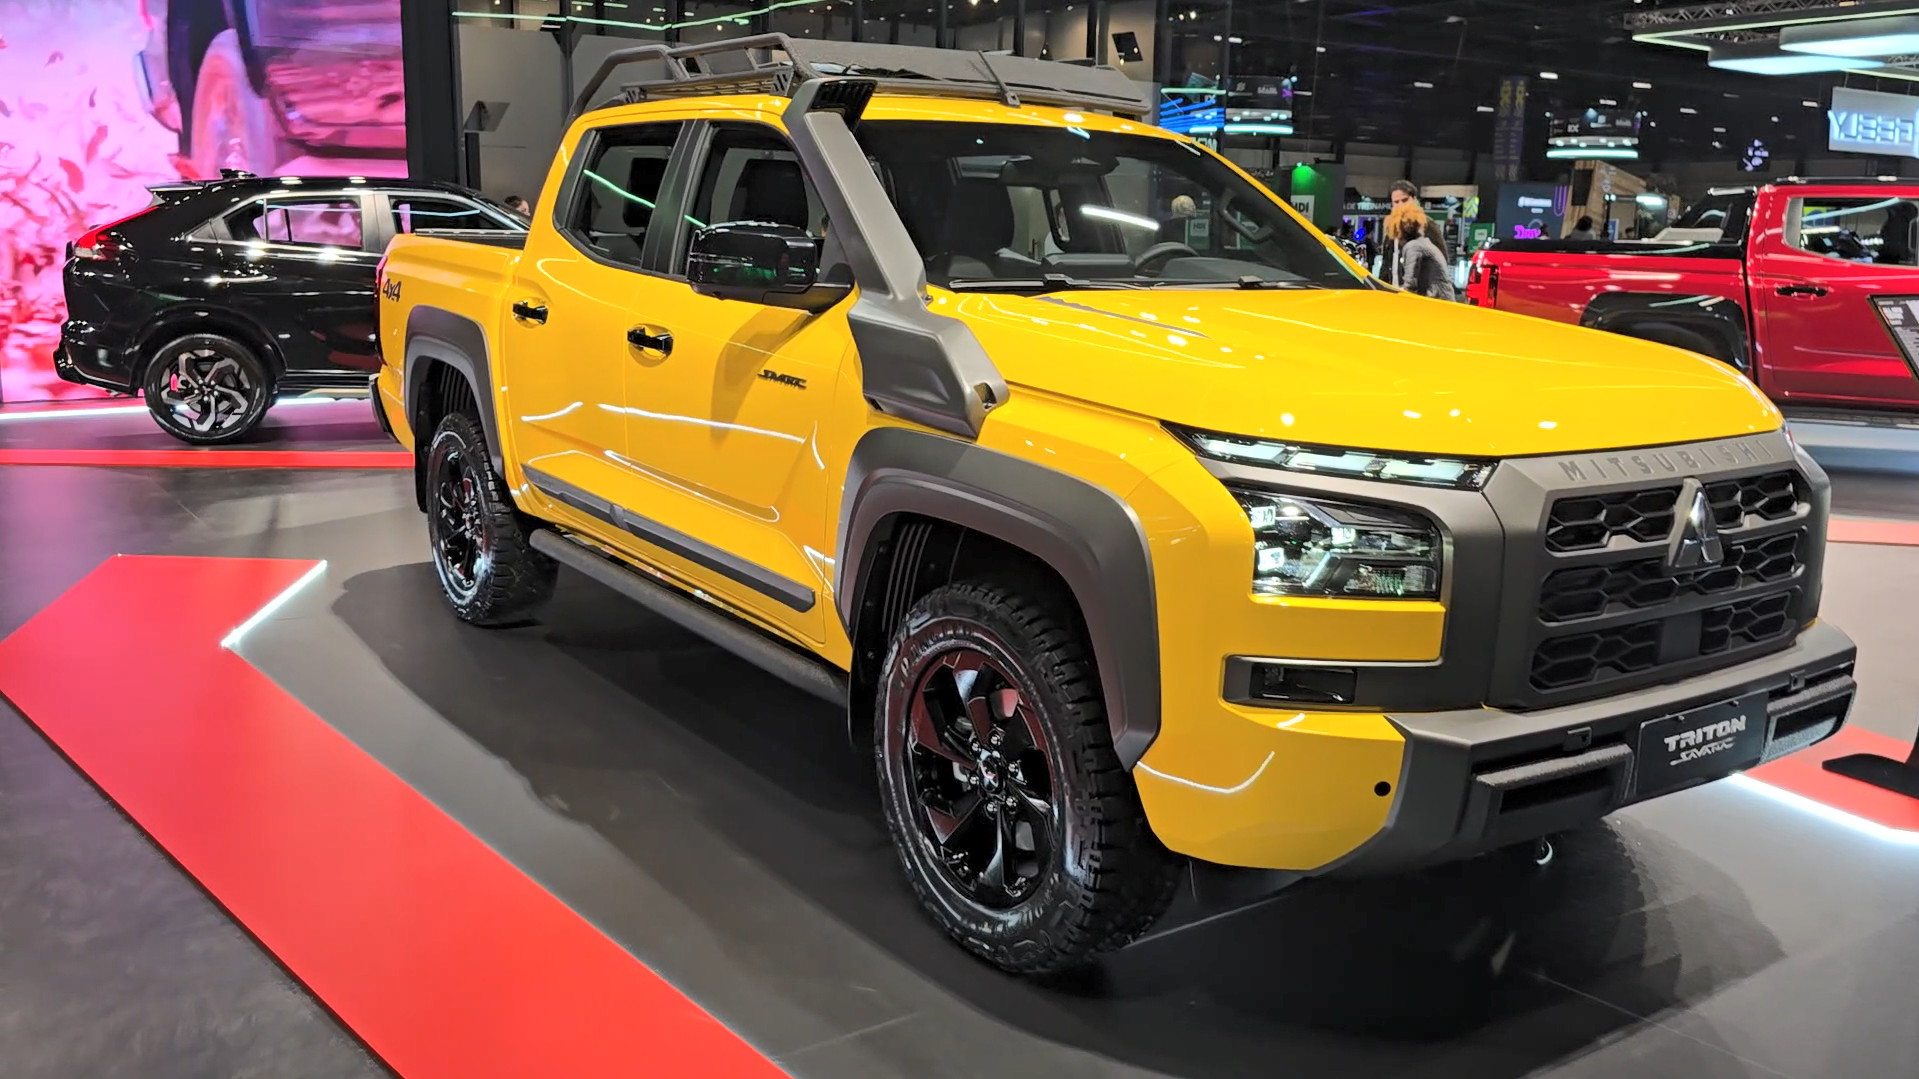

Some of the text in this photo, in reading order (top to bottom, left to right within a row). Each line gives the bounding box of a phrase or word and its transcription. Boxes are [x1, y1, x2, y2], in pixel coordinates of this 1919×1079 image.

[382, 278, 402, 303] 4x4
[1557, 439, 1775, 482] MITSUBISHI
[1663, 714, 1747, 753] TRITON
